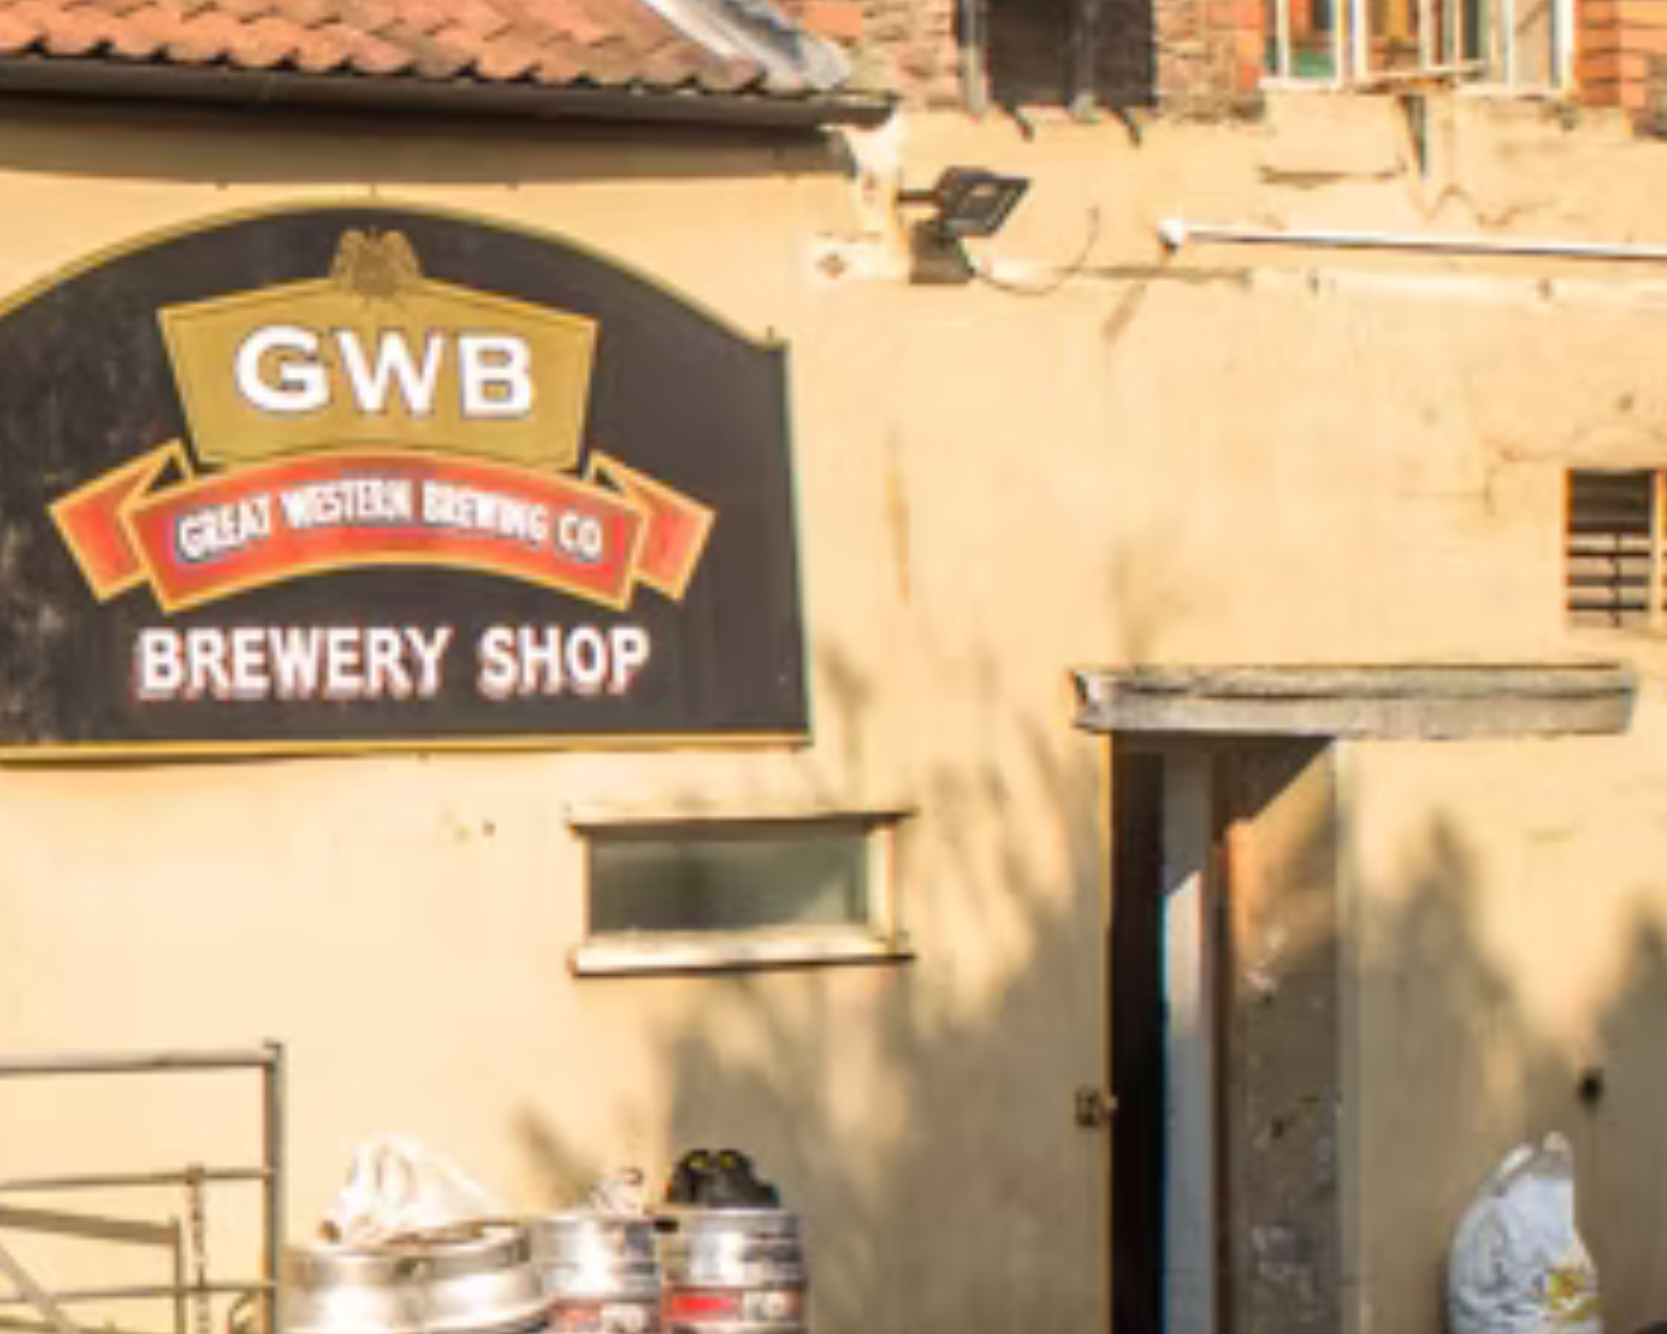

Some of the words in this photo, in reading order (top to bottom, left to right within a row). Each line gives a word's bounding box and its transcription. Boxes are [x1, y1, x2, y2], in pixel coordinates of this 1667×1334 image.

[233, 324, 532, 415] GWB
[177, 494, 269, 560] GREAT
[280, 479, 412, 528] WESTERN
[422, 479, 547, 544] BREWING
[558, 509, 602, 559] CO
[137, 628, 452, 700] BREWERY
[478, 627, 651, 697] SHOP
